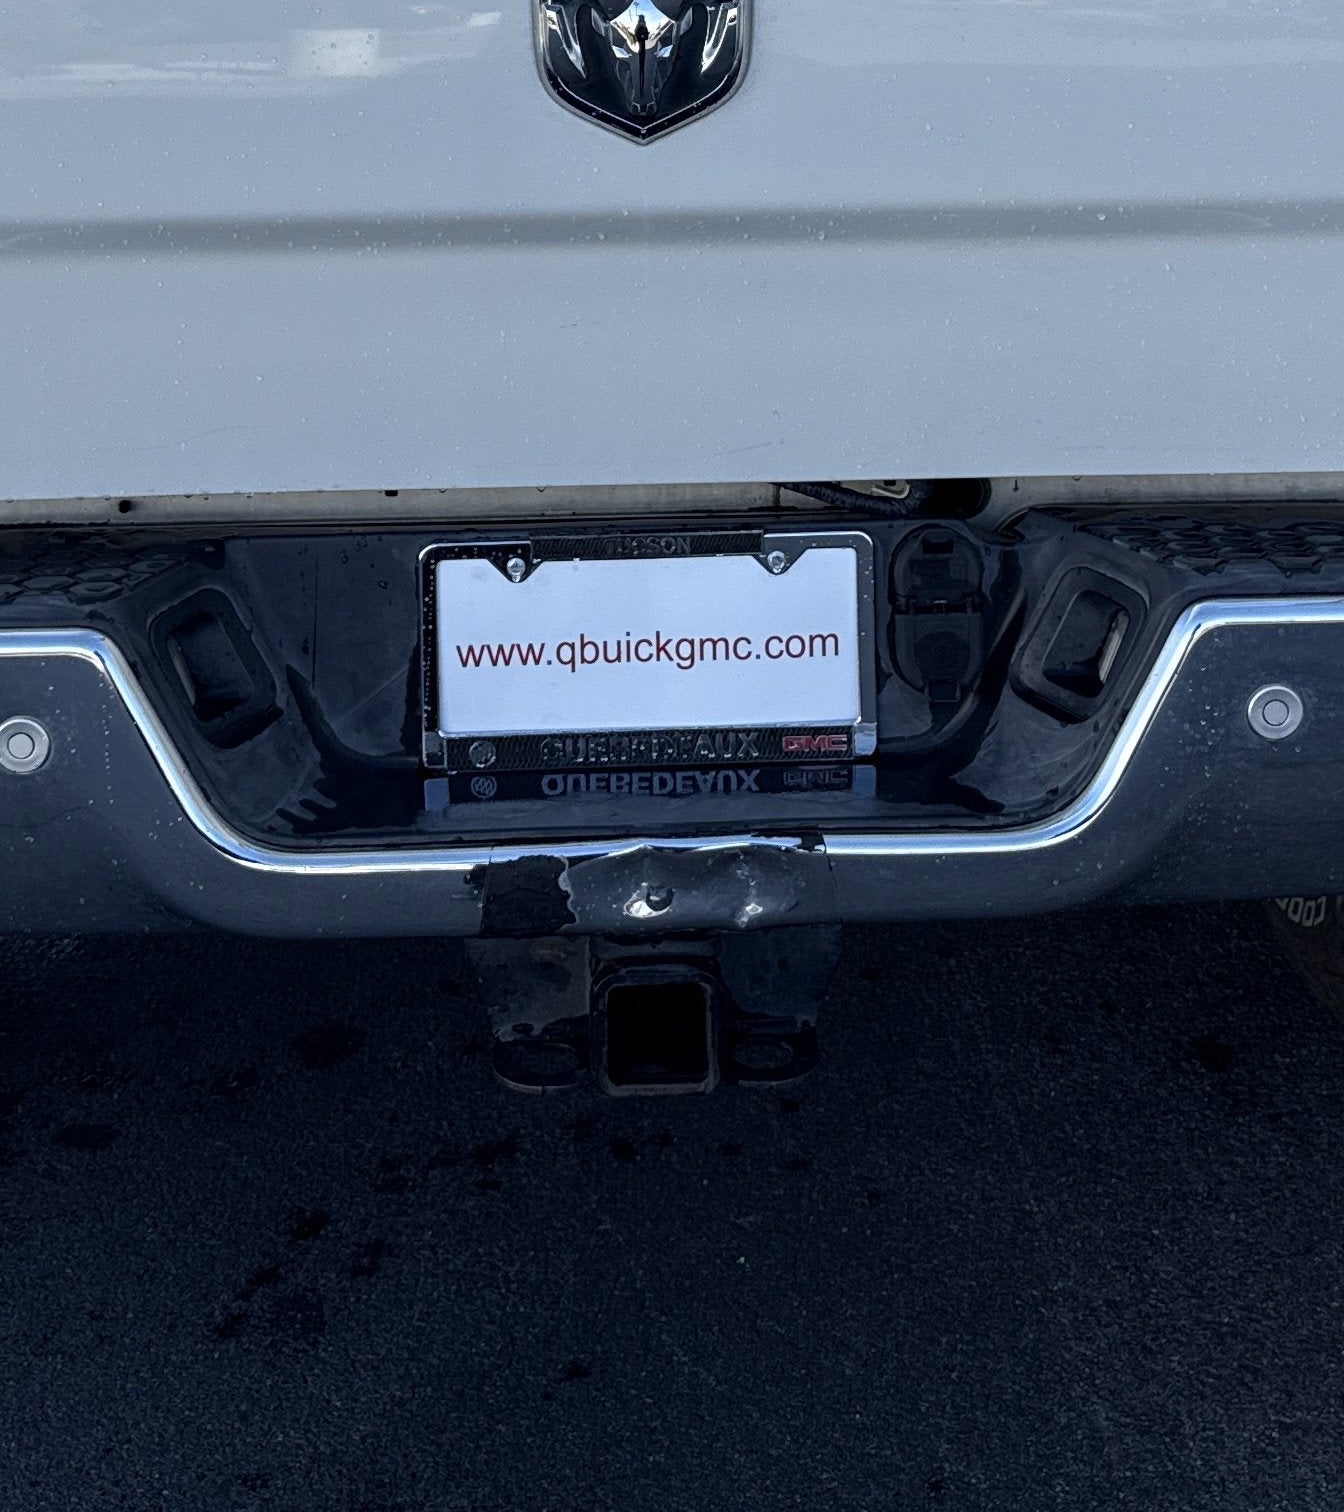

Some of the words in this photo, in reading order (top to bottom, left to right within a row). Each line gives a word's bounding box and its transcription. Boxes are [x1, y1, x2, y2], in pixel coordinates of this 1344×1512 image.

[456, 631, 840, 673] www.qbuickgmc.com
[540, 731, 760, 761] QUEBEDEAUX
[782, 734, 848, 753] GMC
